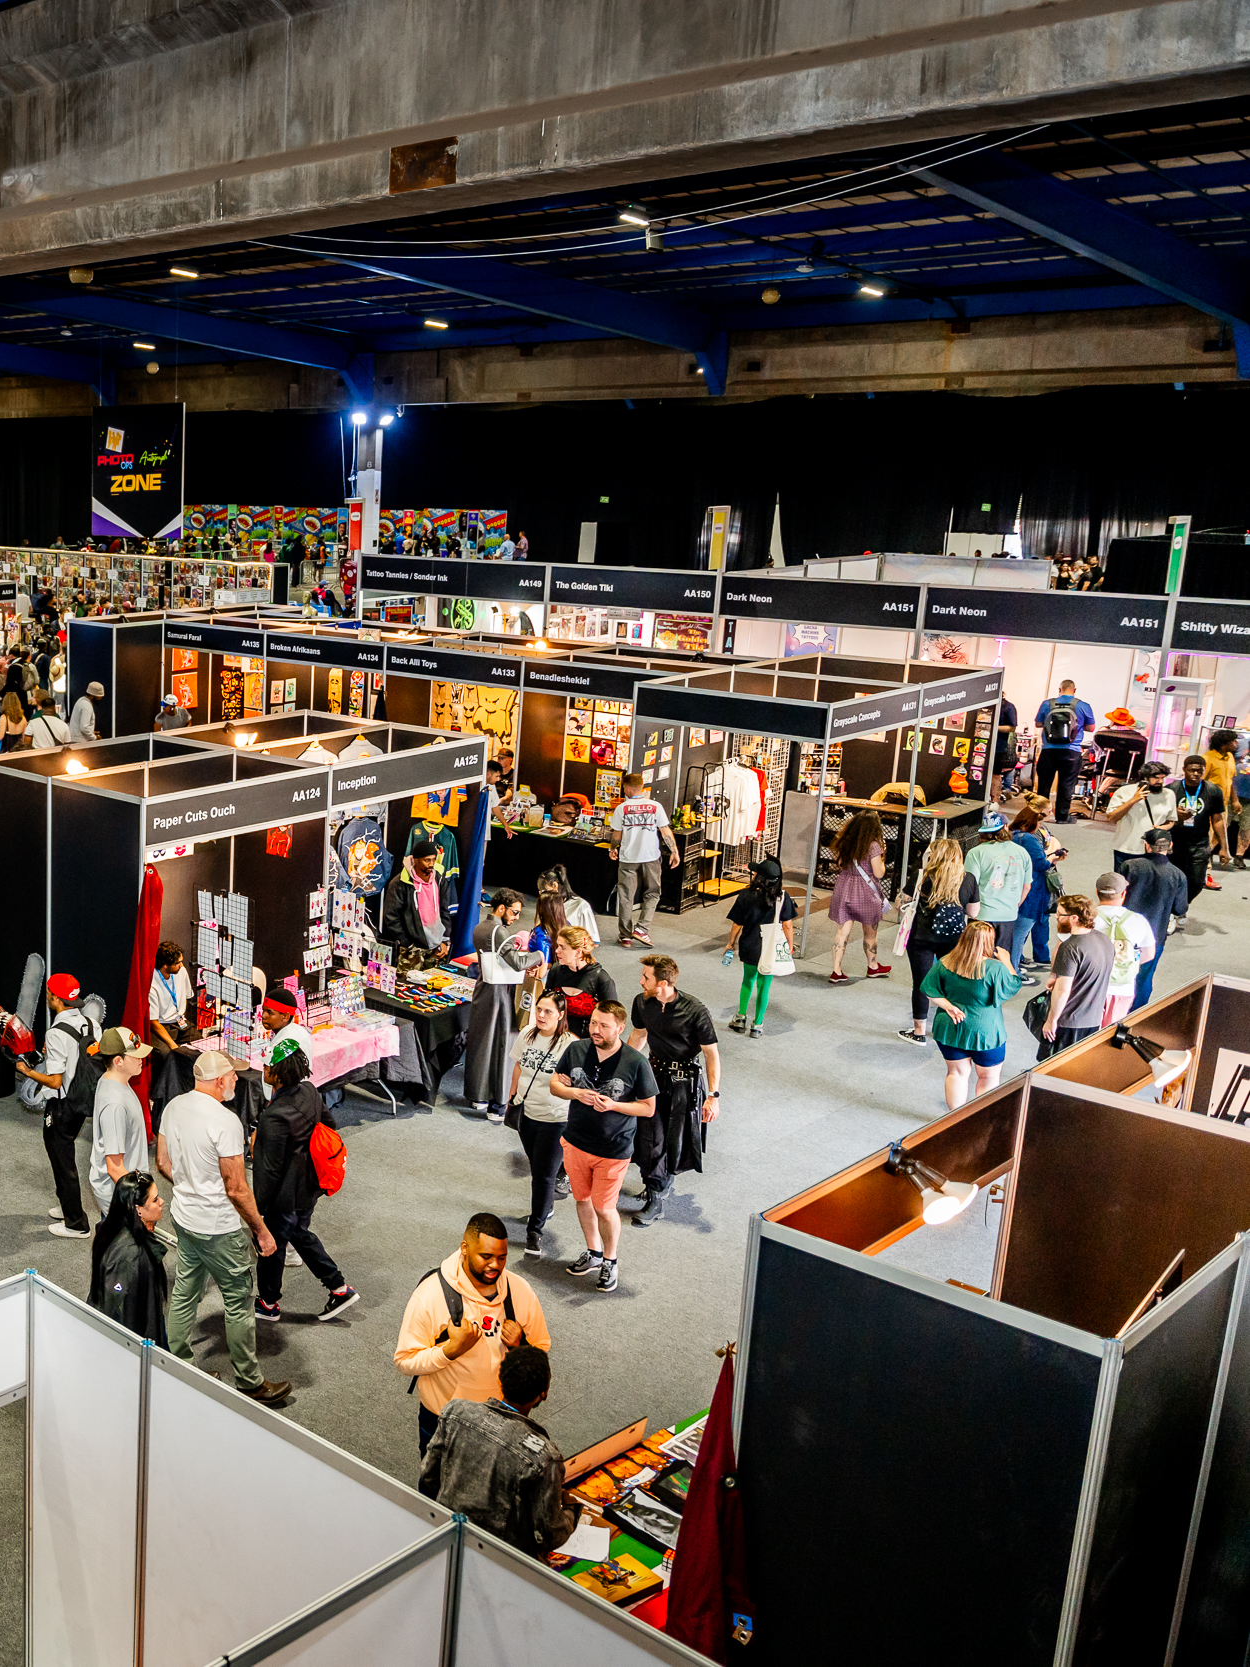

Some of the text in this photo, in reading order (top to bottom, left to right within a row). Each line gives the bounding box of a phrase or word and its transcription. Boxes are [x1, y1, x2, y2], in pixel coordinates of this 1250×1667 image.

[97, 453, 134, 466] PHOTO
[120, 461, 133, 470] OPS
[110, 473, 162, 492] ZONE
[366, 569, 383, 579] Tattoo
[413, 573, 436, 582] Sonder
[437, 574, 448, 582] Ink
[519, 578, 542, 588] AA149
[555, 581, 614, 593] The Golden Tiki
[684, 589, 712, 599] AA150
[726, 592, 773, 604] Dark Neon
[882, 602, 914, 612] AA151
[932, 604, 987, 617] Dark Neon
[1120, 616, 1159, 629] AA151
[1181, 621, 1250, 635] Shitty Wiza
[242, 640, 260, 649] AA135
[270, 642, 321, 656] Broken Afrikaans
[358, 653, 379, 662] AA134
[391, 656, 407, 666] Back
[421, 659, 438, 670] Toys
[491, 667, 515, 677] AA133
[985, 682, 999, 693] AA131
[924, 689, 966, 707] Grayscale Concepts
[902, 700, 917, 712] AA131
[833, 709, 881, 729] Grayscale Concepts
[453, 755, 478, 769] AA125
[337, 774, 377, 792] Inception
[292, 788, 320, 803] AA124
[153, 804, 235, 830] Paper Cuts Ouch
